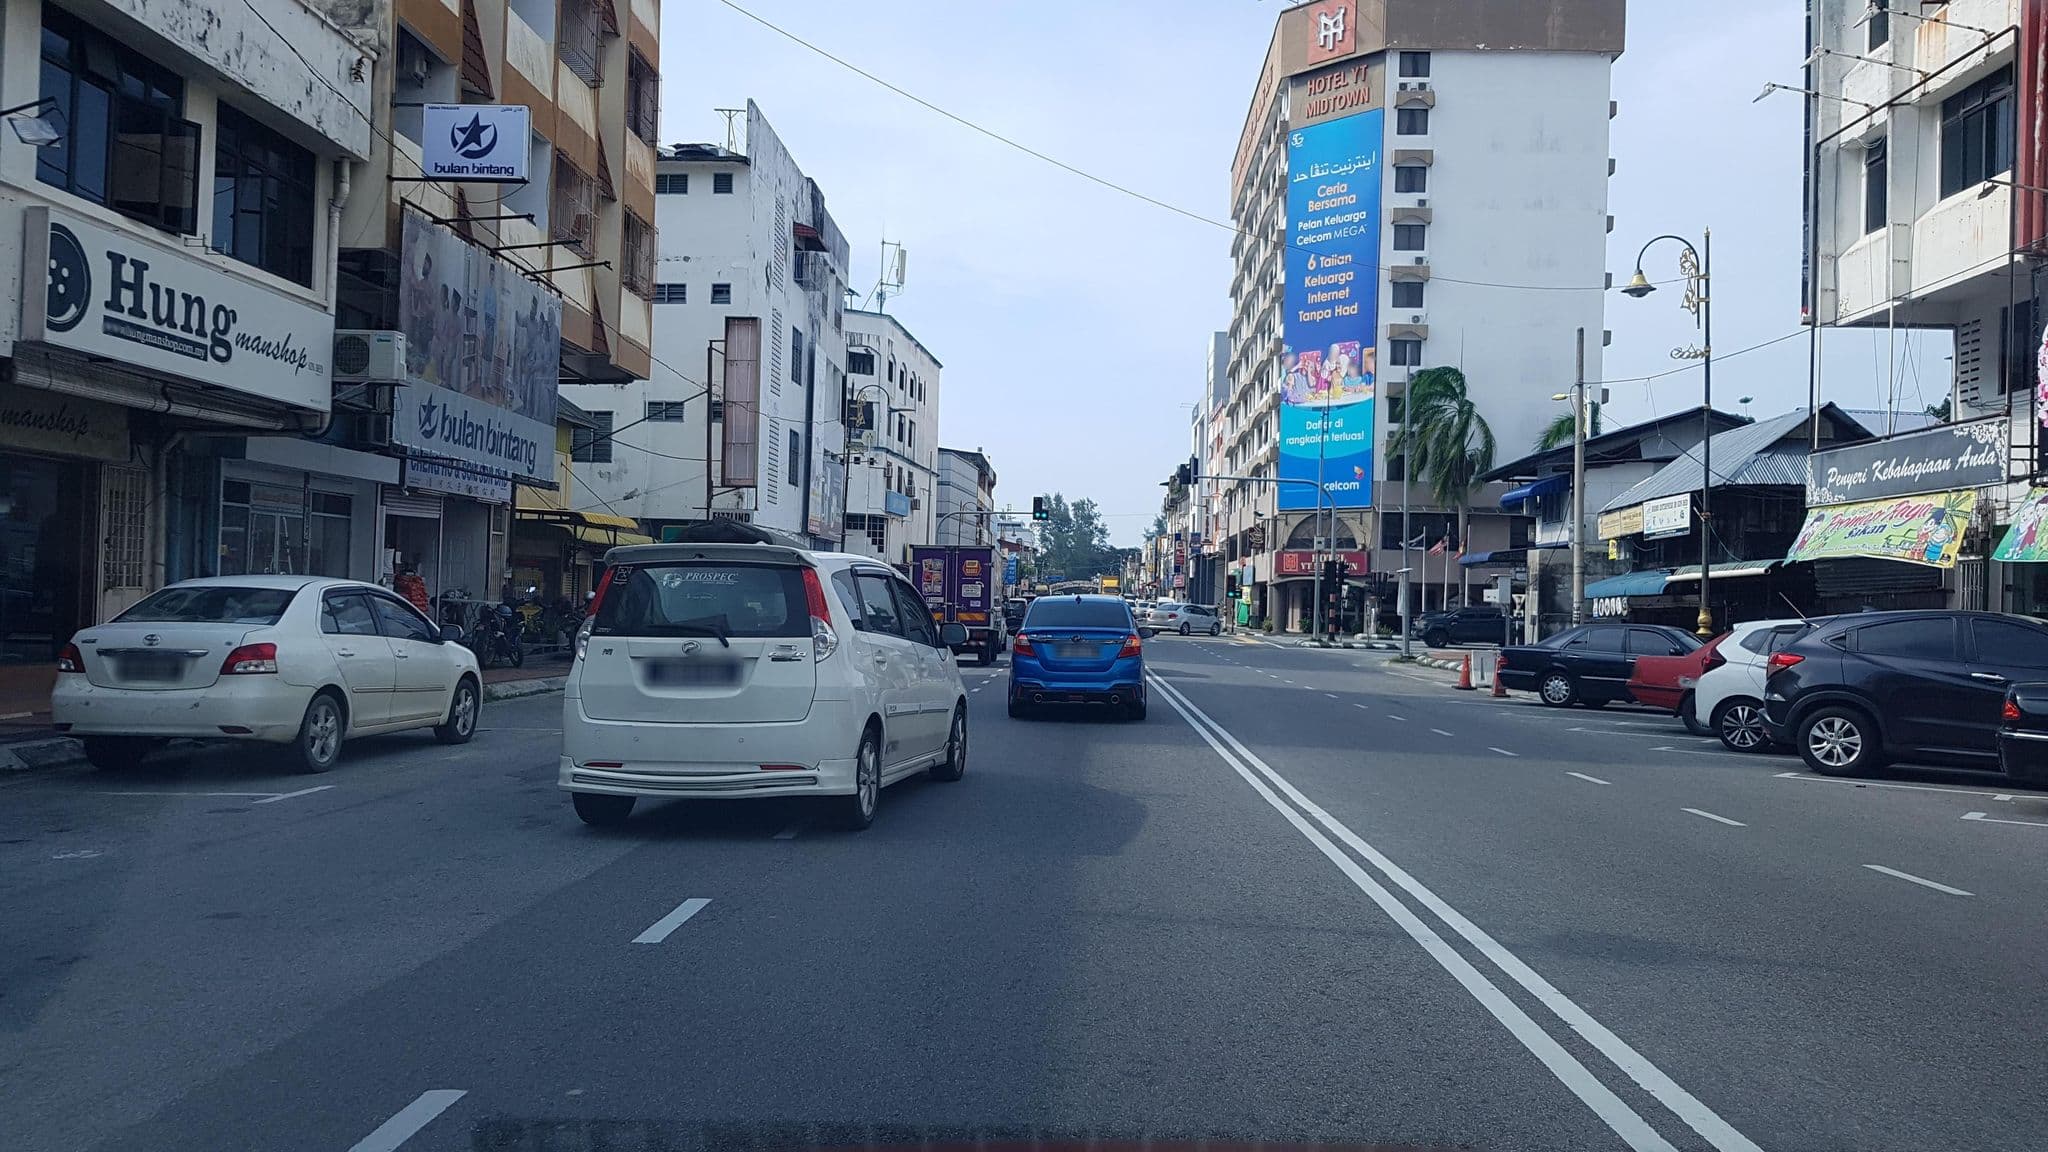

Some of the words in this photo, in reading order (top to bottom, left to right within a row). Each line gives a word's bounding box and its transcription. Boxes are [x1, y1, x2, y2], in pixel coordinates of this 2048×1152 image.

[1307, 71, 1348, 96] HOTEL
[1352, 64, 1368, 84] YT
[1306, 87, 1370, 118] MIDTOWN
[434, 162, 469, 174] bulan
[472, 163, 514, 176] bintang
[1317, 181, 1348, 198] Ceria
[1308, 193, 1356, 212] Bersama
[1298, 219, 1322, 231] Pelan
[1324, 211, 1366, 226] Keluarga
[1296, 232, 1331, 246] Celcom
[1307, 254, 1316, 271] 6
[1320, 254, 1352, 268] Talian
[1304, 271, 1354, 287] Keluarga
[1307, 287, 1350, 304] Internet
[104, 250, 237, 363] Hung
[1298, 309, 1331, 323] Tanpa
[1335, 302, 1358, 317] Had
[235, 332, 308, 376] manshop
[1335, 418, 1343, 428] di
[440, 403, 484, 451] bulan
[486, 418, 537, 475] bintang
[1286, 434, 1329, 446] rangkaian
[1827, 467, 1868, 490] Penyeri
[1872, 456, 1952, 482] Kebahagiaan
[1954, 444, 1997, 470] Anda
[1323, 481, 1360, 491] celcom
[685, 572, 735, 581] PROSPEC
